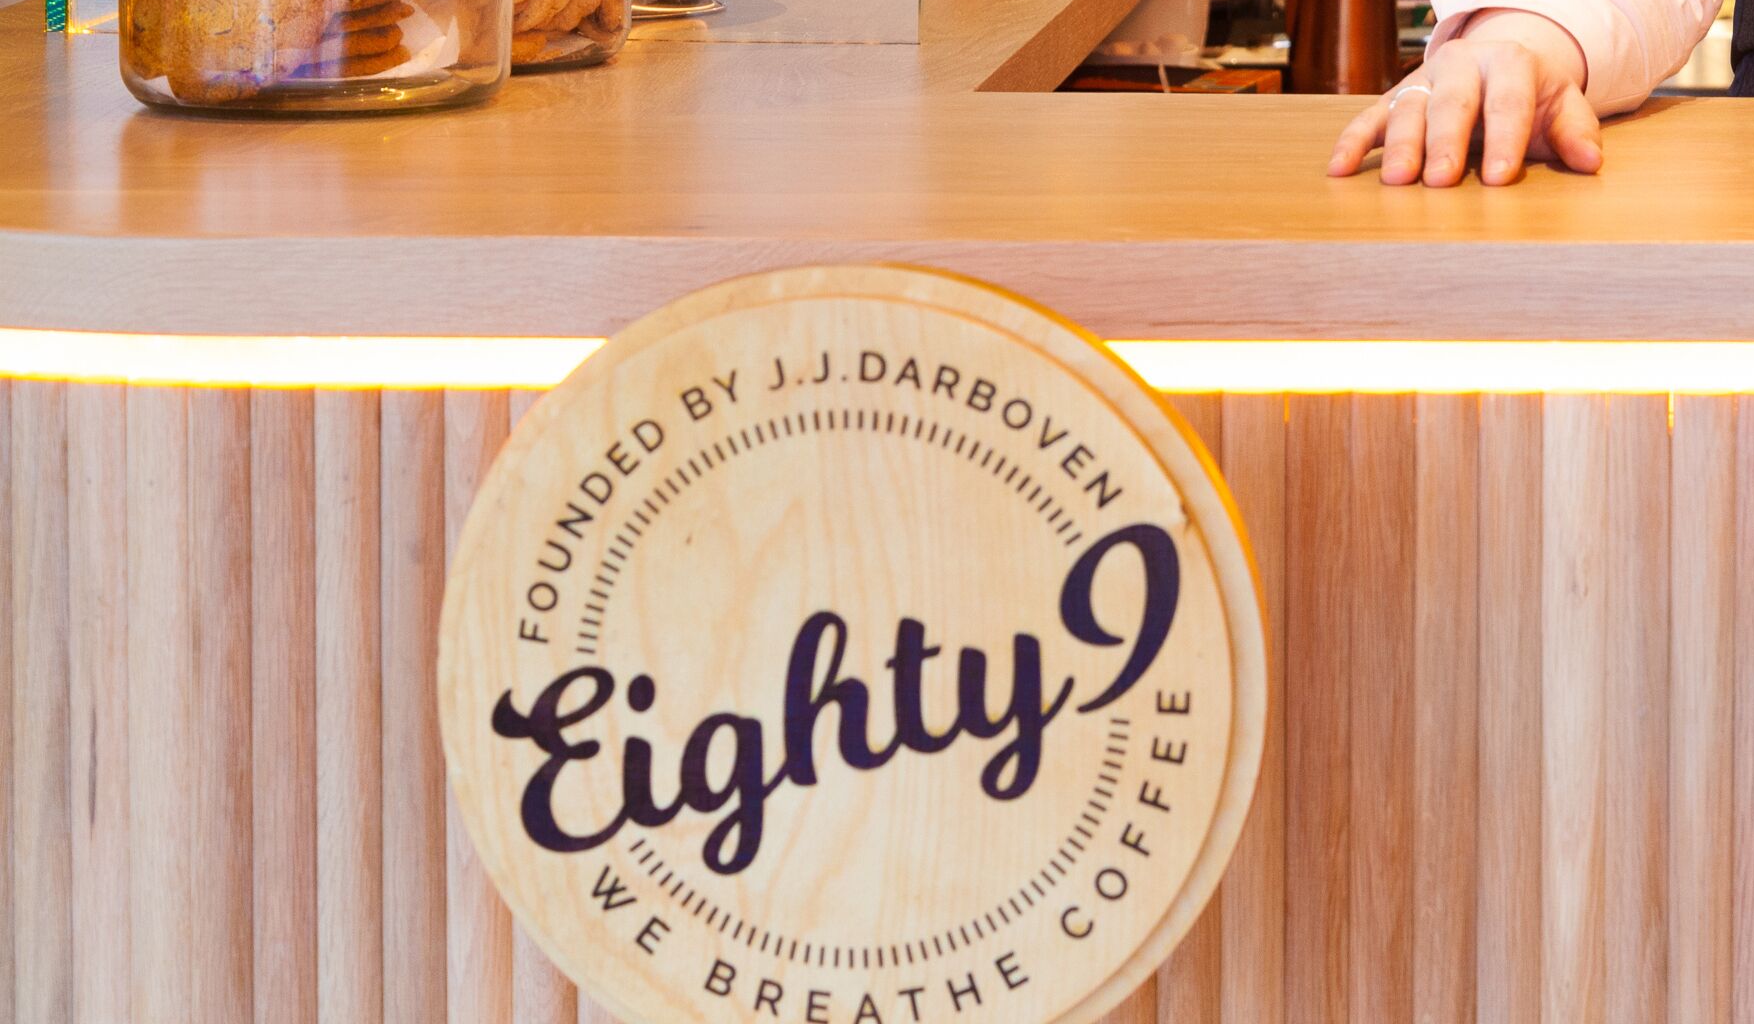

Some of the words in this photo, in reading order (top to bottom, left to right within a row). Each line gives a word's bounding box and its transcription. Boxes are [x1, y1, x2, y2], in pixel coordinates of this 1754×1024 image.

[519, 417, 667, 645] FOUNDED
[681, 369, 743, 423] BY
[491, 522, 1182, 876] Eighty9
[591, 864, 672, 955] WE
[703, 953, 1028, 1024] BREATHE
[1059, 687, 1193, 941] COFFEE
